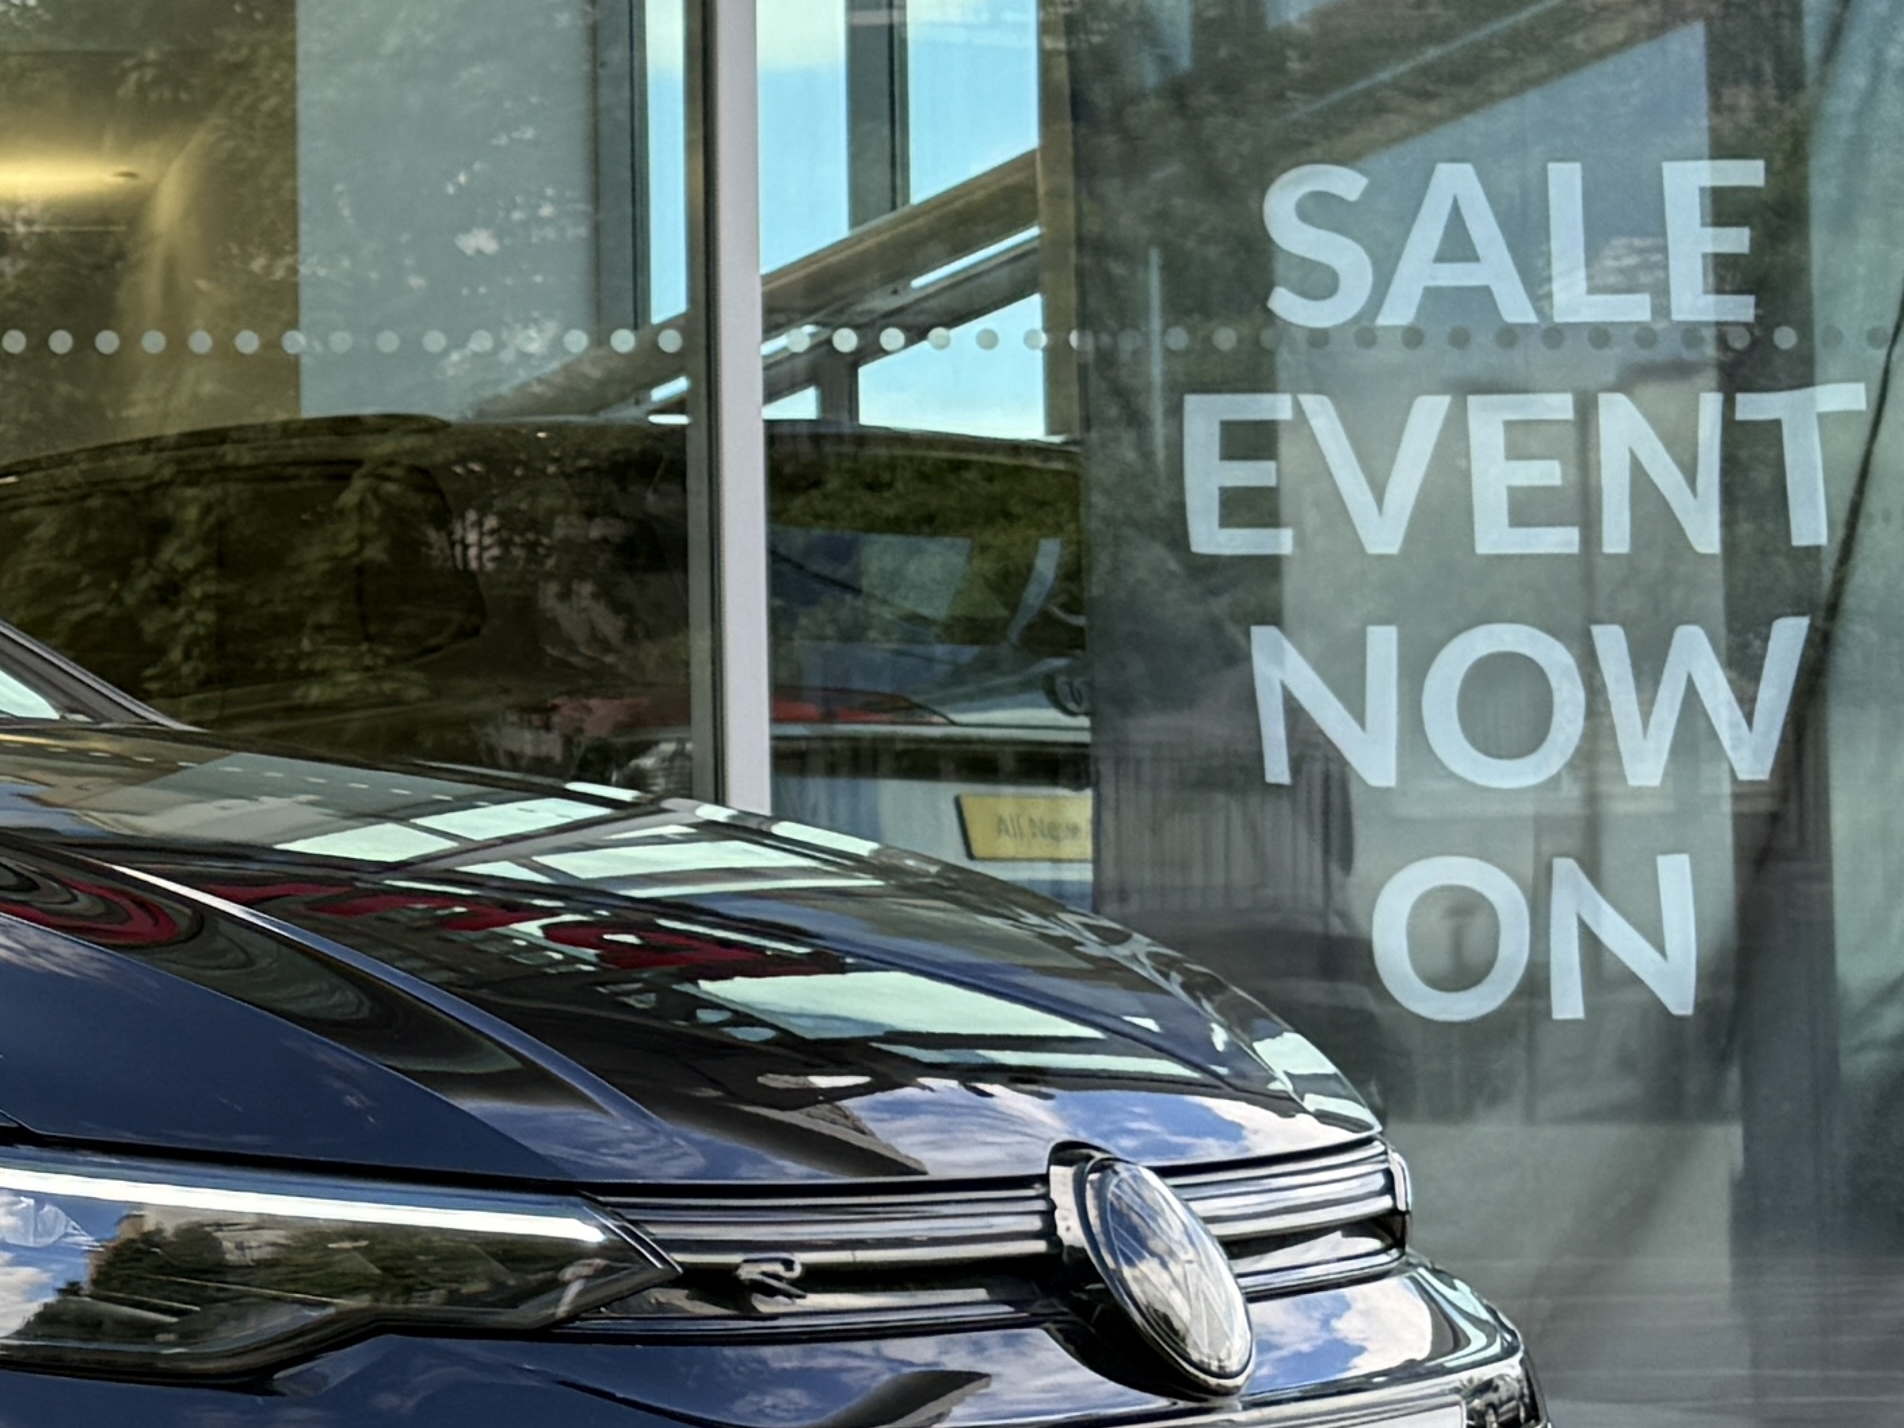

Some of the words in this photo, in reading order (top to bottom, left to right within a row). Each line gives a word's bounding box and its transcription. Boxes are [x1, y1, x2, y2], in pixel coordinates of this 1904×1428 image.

[1262, 158, 1767, 329] SALE
[1182, 381, 1868, 557] EVENT
[1249, 614, 1812, 791] NOW
[1370, 851, 1699, 1023] ON
